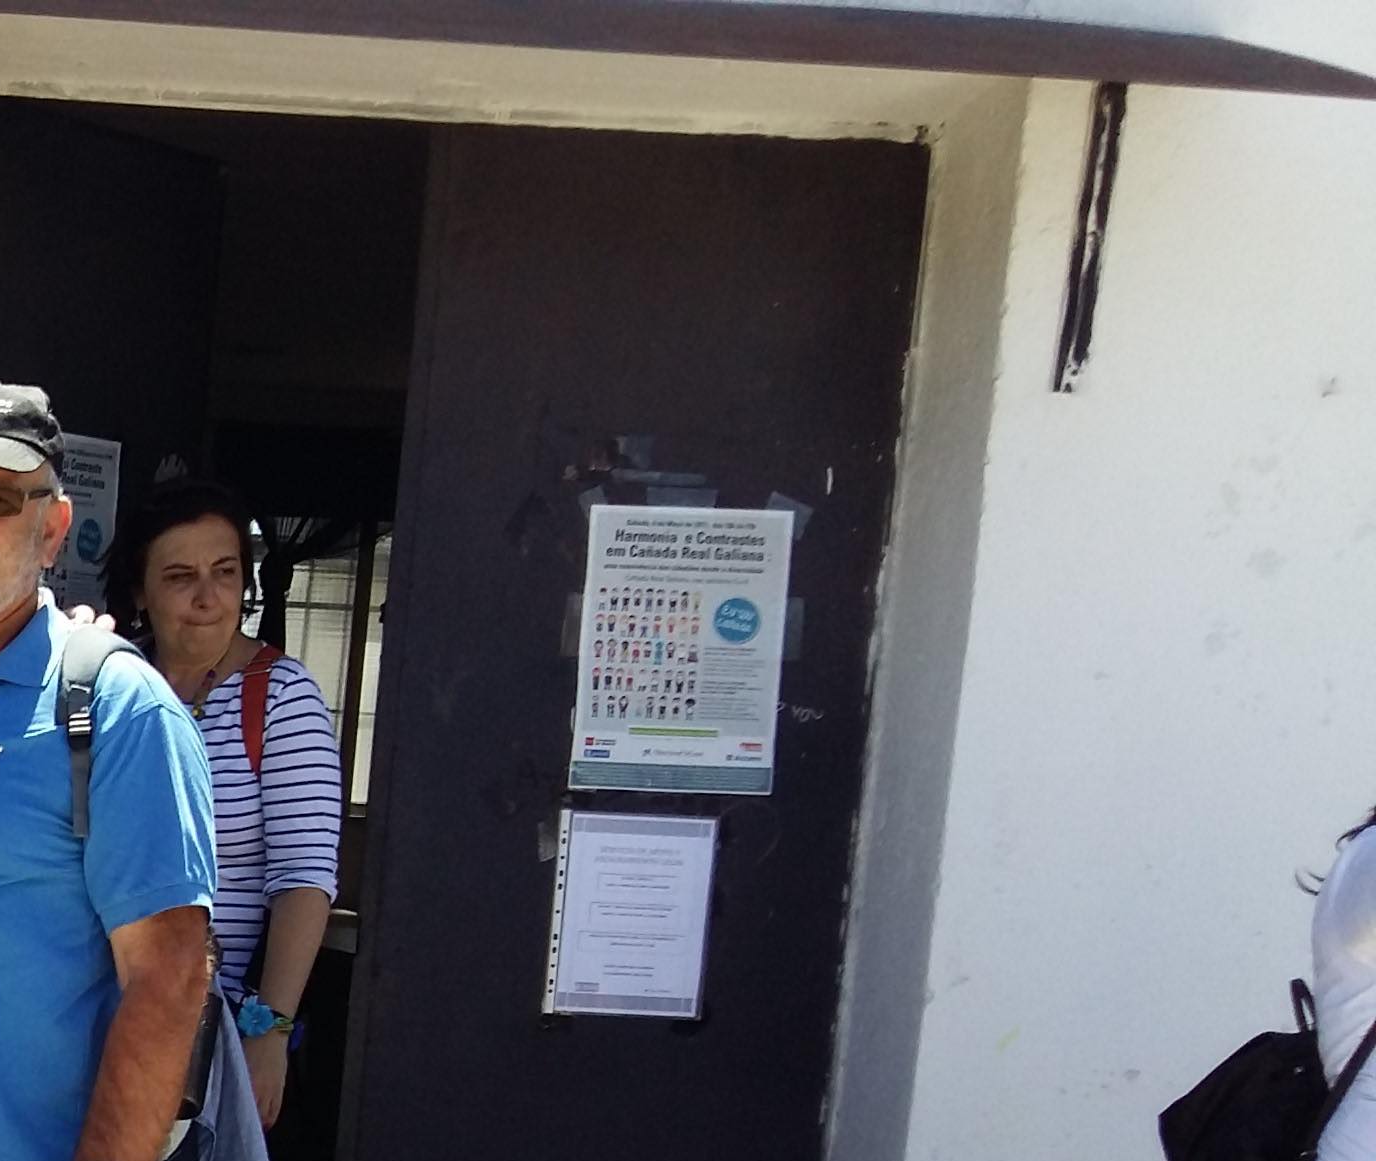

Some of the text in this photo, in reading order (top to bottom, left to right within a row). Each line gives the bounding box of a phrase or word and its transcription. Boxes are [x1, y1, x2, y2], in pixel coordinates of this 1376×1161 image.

[614, 528, 766, 546] Harmonia e Contrastes
[605, 547, 626, 558] em
[680, 546, 711, 560] Real
[713, 548, 765, 562] Galiana
